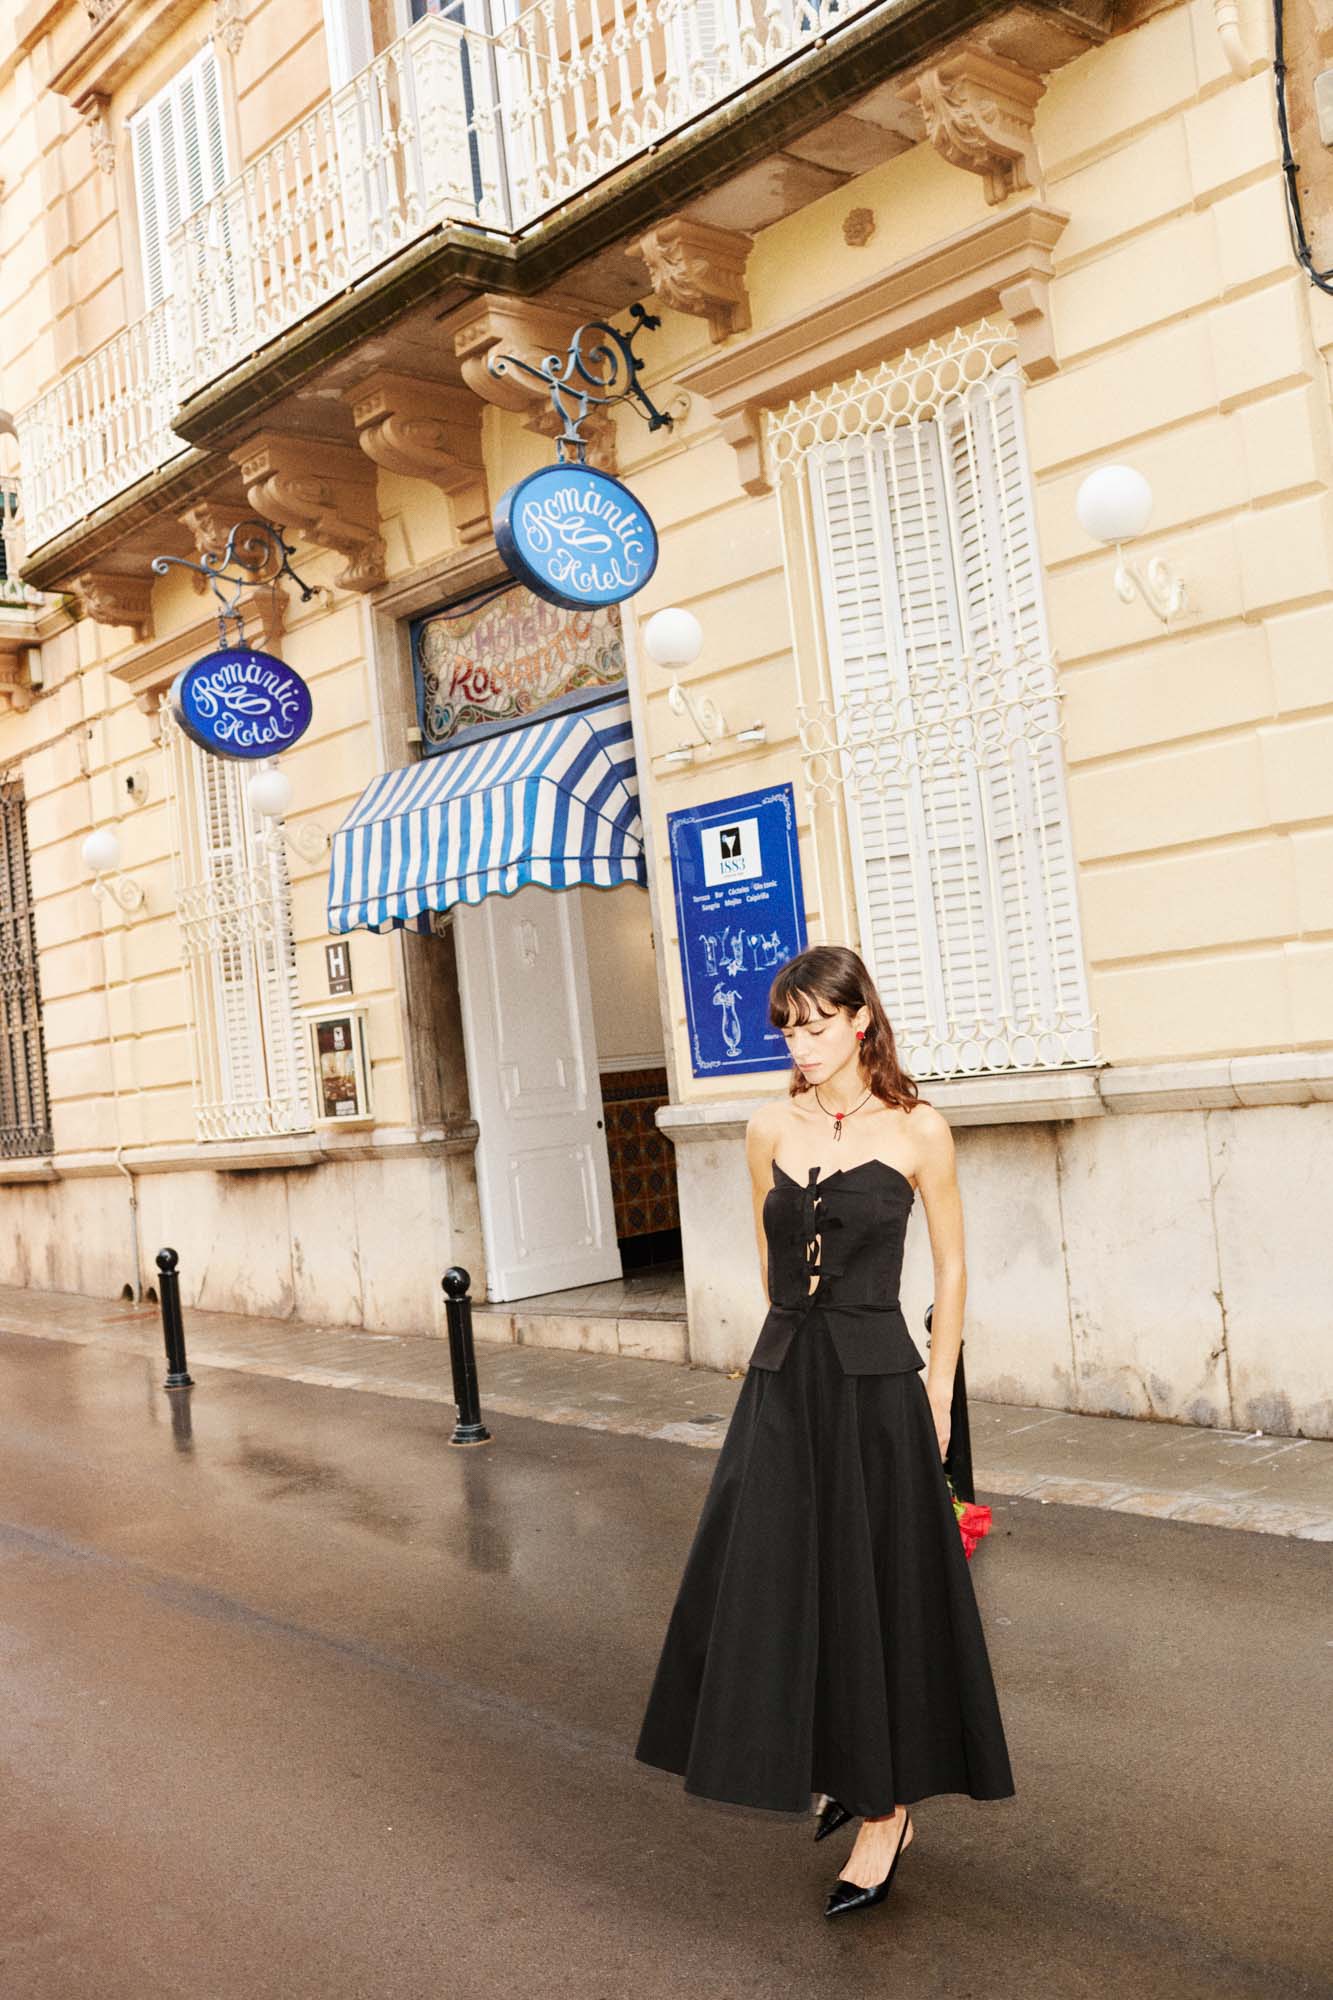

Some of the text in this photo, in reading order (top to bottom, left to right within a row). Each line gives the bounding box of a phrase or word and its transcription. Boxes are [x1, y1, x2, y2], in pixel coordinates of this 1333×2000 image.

[547, 547, 639, 592] Hotel
[213, 711, 294, 747] Hotel
[328, 945, 346, 978] H
